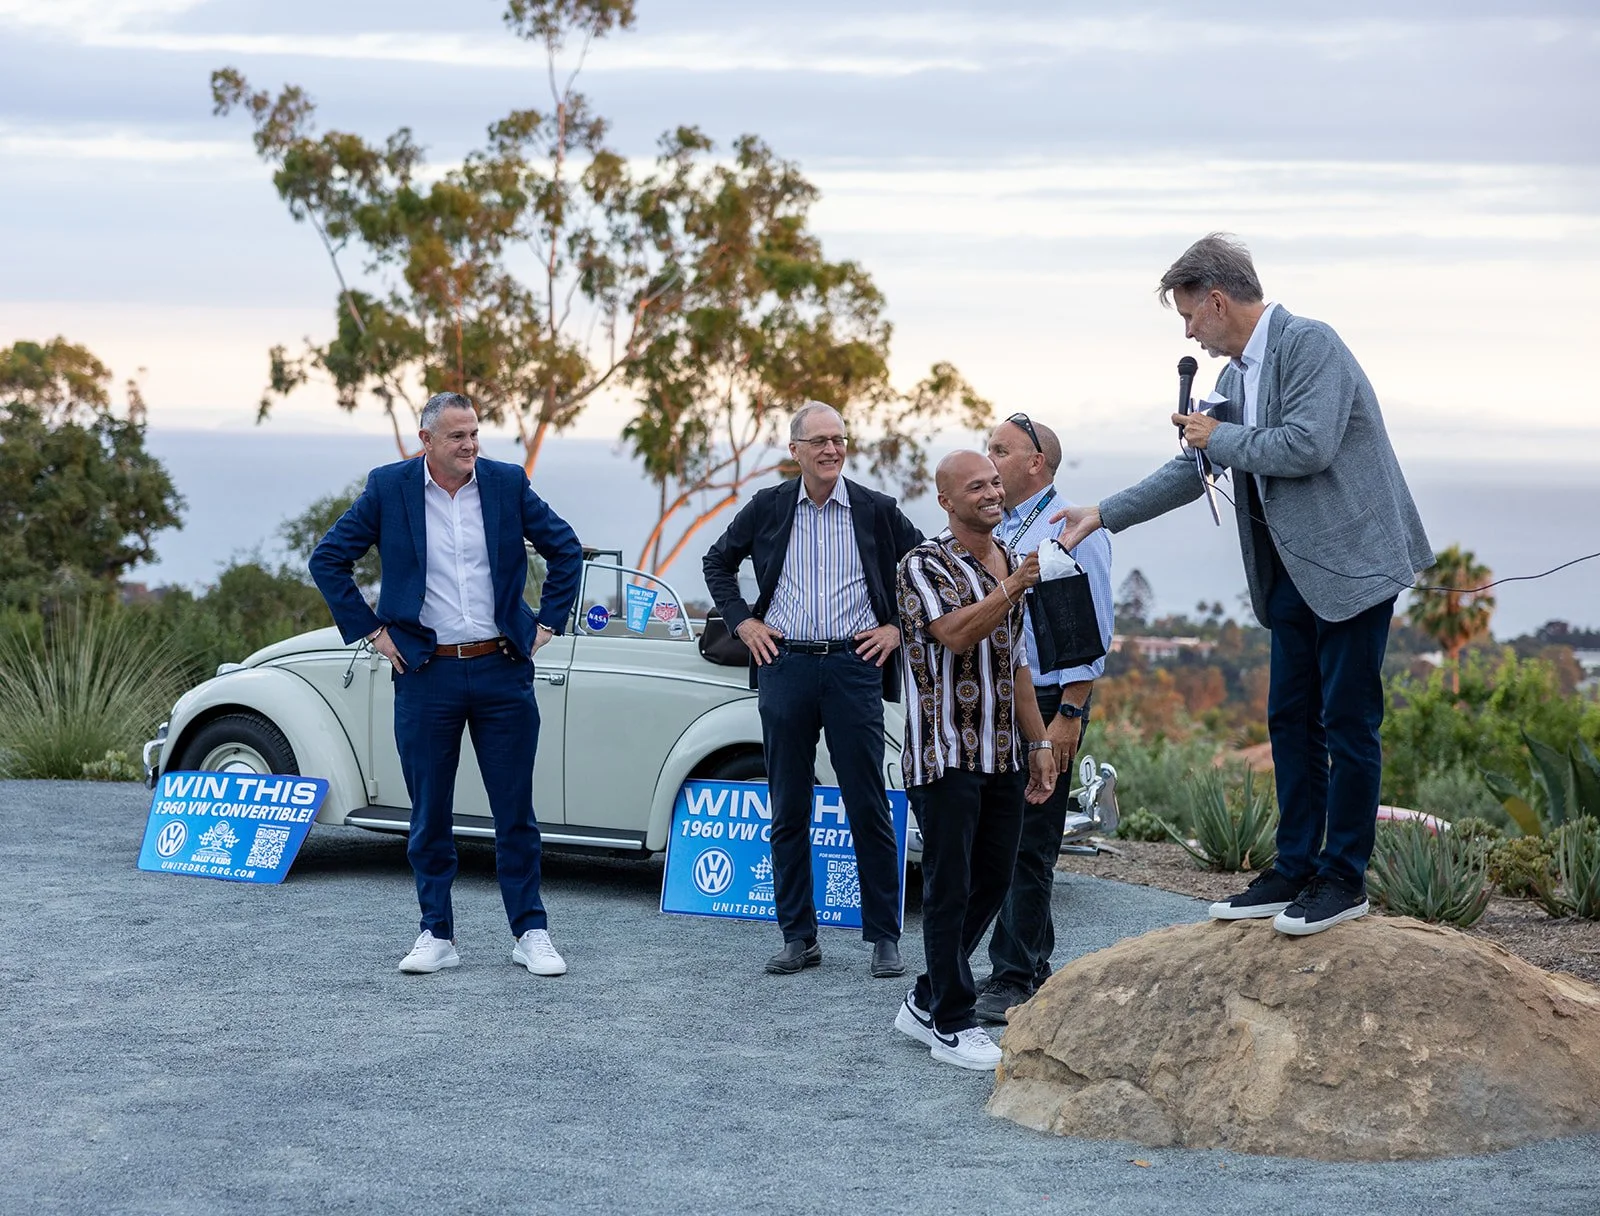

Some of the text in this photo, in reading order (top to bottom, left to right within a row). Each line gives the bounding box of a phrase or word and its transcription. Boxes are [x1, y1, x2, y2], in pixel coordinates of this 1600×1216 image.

[1010, 526, 1028, 547] UTURES
[1025, 508, 1039, 526] START
[589, 613, 607, 624] NASA
[164, 776, 317, 805] WIN THIS
[155, 801, 314, 823] 1960 VW CONVERTIBLE!
[684, 787, 772, 819] WIN
[681, 820, 723, 839] 1960
[728, 823, 758, 840] VW
[191, 854, 210, 862] RALLY
[216, 857, 232, 865] KIDS
[161, 861, 256, 879] UNITEDBG.ORG.COM
[748, 891, 775, 901] RALLY
